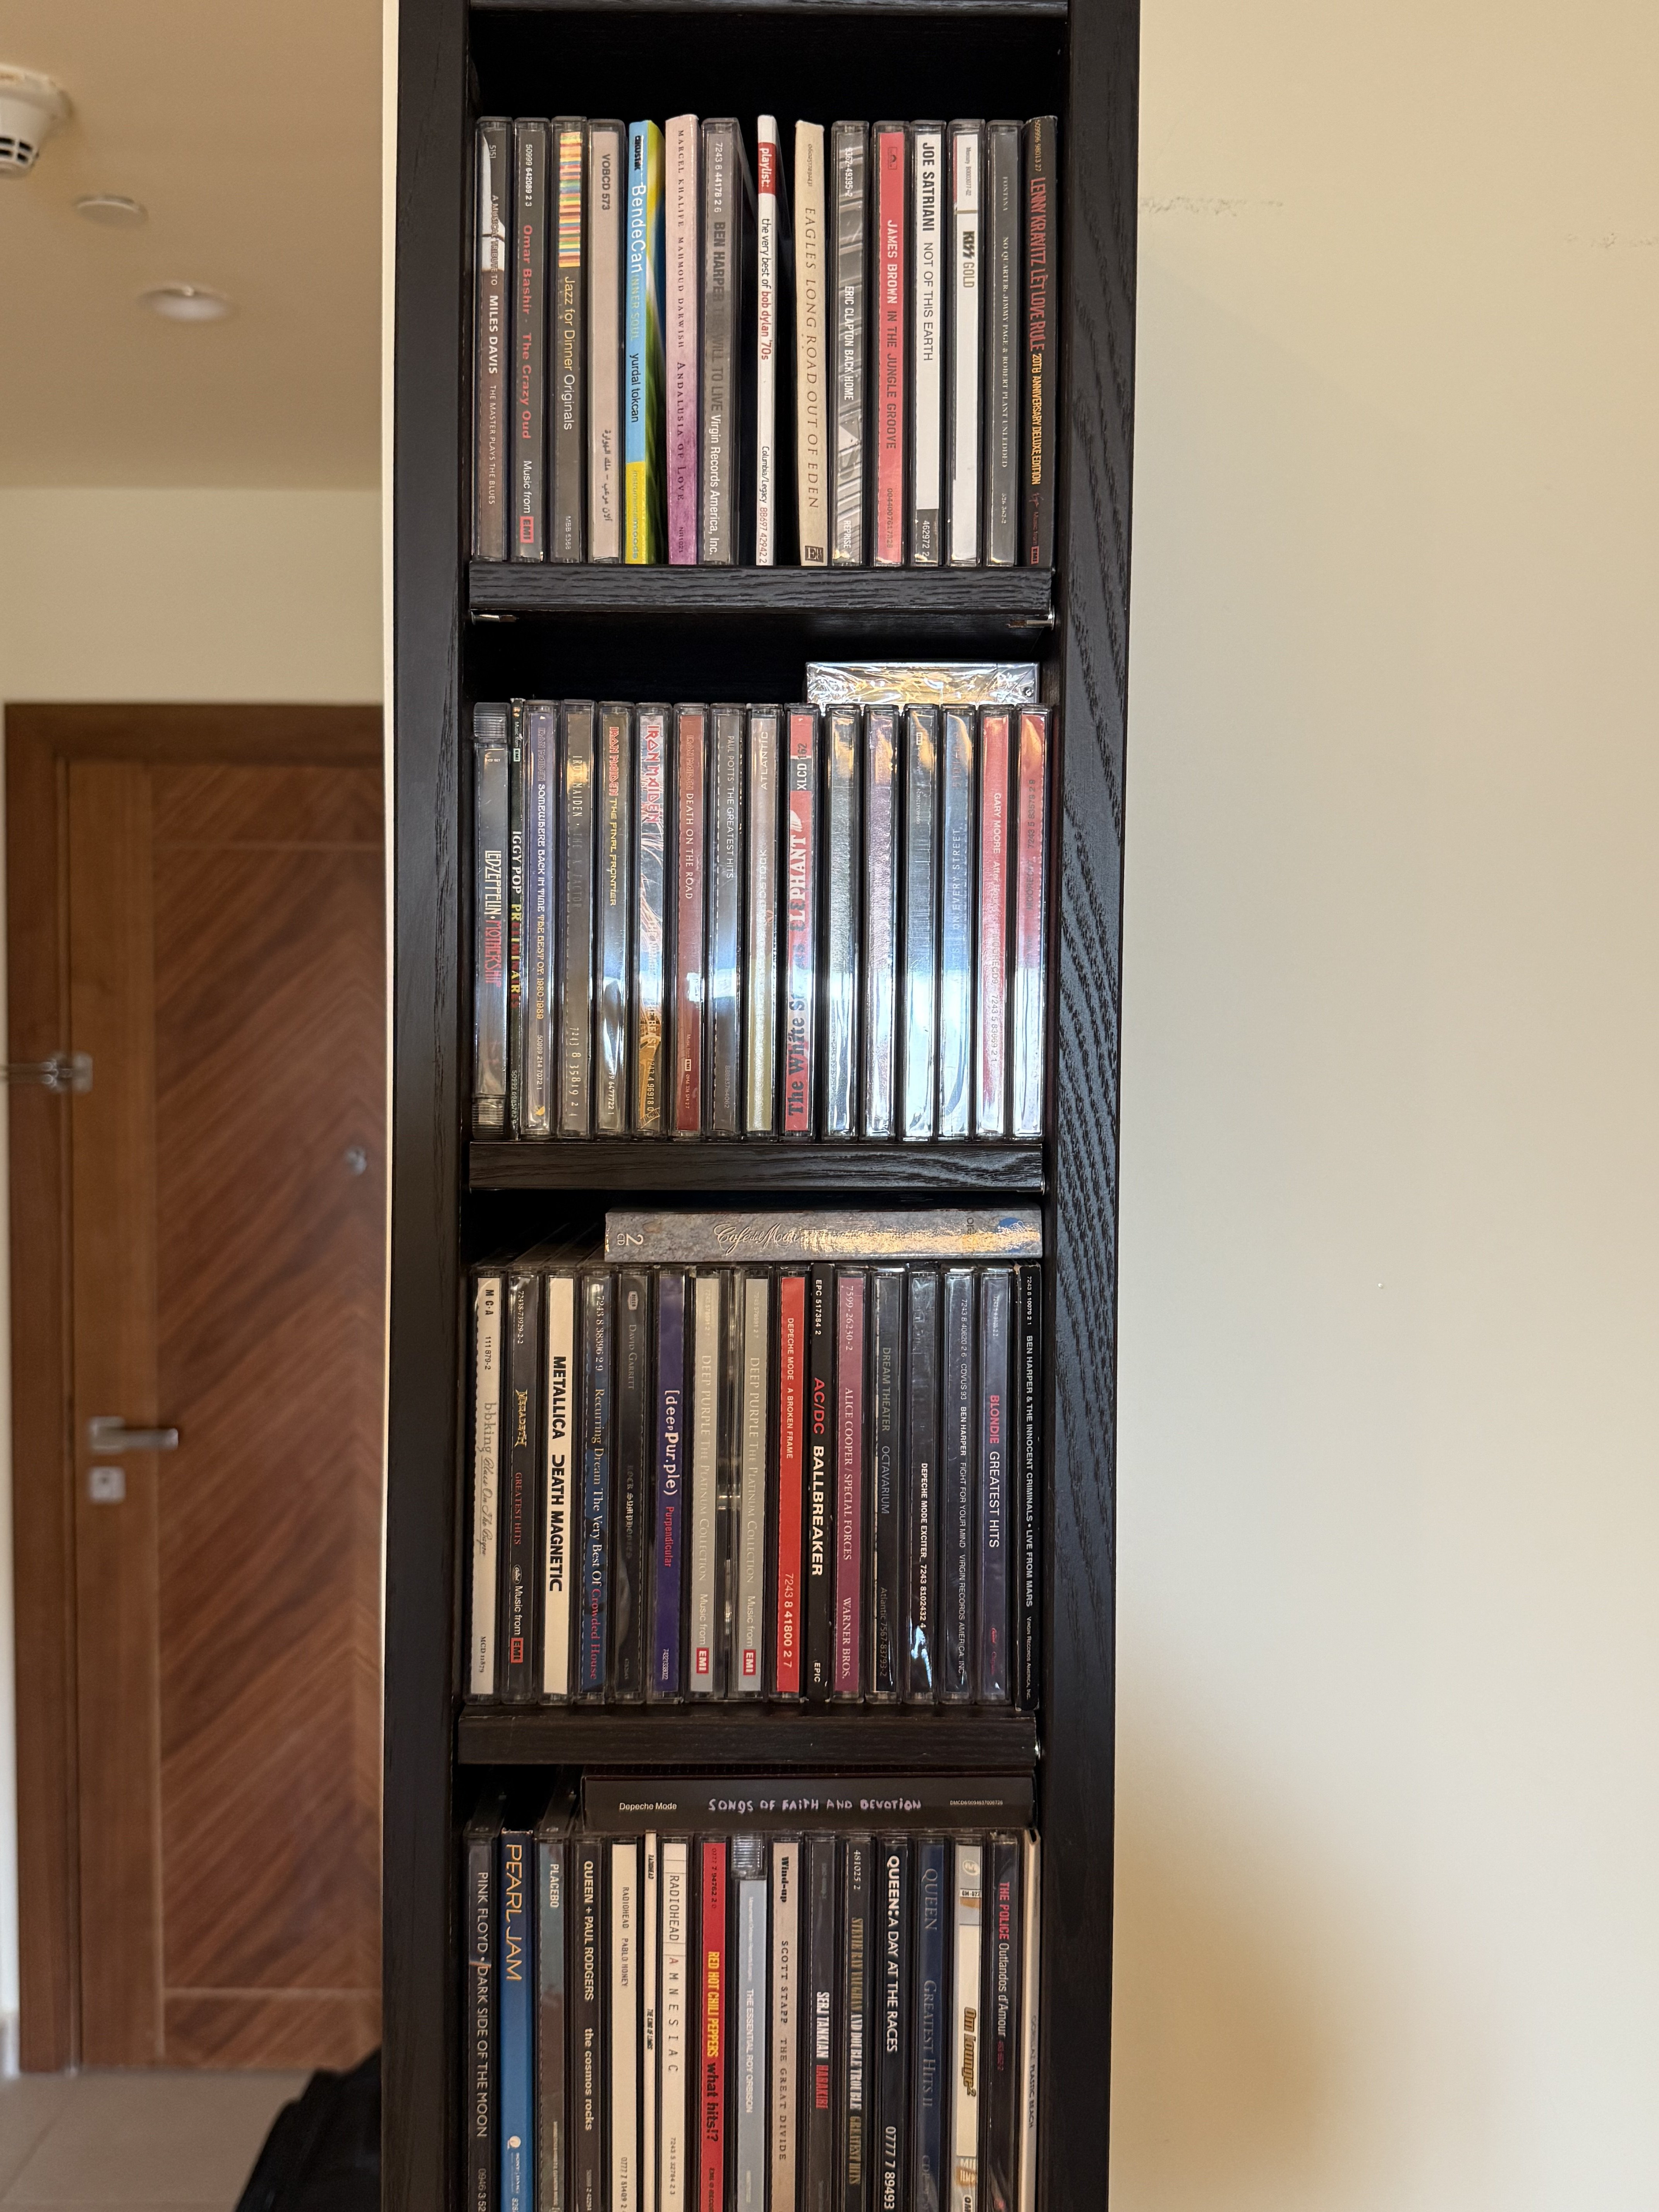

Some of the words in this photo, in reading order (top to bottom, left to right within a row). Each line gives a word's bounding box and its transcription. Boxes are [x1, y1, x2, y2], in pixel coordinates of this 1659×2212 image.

[922, 143, 934, 166] JOE
[922, 172, 935, 231] SATRIANI
[762, 219, 770, 234] the
[805, 208, 816, 270] EAGLES
[887, 220, 897, 258] JAMES
[523, 225, 533, 264] Omar
[759, 236, 769, 256] very
[924, 242, 933, 268] NOT
[762, 258, 771, 277] best
[762, 279, 771, 289] of
[887, 264, 897, 304] BROWN
[924, 271, 933, 287] OF
[523, 268, 533, 314] Bashir
[564, 276, 575, 304] Jazz
[761, 291, 771, 309] bob
[805, 279, 816, 328] LONG
[844, 286, 854, 305] ERIC
[924, 290, 933, 317] THIS
[489, 295, 498, 332] MILES
[565, 309, 575, 326] for
[760, 311, 771, 337] dylan
[844, 308, 854, 346] CLAPTON
[887, 311, 897, 322] IN
[522, 335, 531, 361] The
[563, 330, 575, 371] Dinner
[886, 327, 896, 347] THE
[923, 322, 933, 361] EARTH
[489, 336, 498, 374] DAVIS
[806, 335, 817, 384] ROAD
[844, 350, 854, 373] BACK
[519, 365, 531, 405] Crazy
[844, 376, 854, 400] HOME
[886, 353, 896, 397] JUNGLE
[561, 374, 575, 430] Originals
[807, 391, 817, 428] OUT
[522, 410, 531, 439] Oud
[886, 403, 896, 449] GROOVE
[807, 434, 818, 455] OF
[523, 460, 532, 489] Music
[808, 462, 819, 508] EDEN
[523, 491, 532, 514] from
[523, 519, 531, 541] EMI
[727, 756, 735, 782] POTTS
[760, 732, 768, 790] ATLANTIC
[538, 783, 546, 847] SOMEWHERE
[685, 793, 694, 824] DEATH
[993, 793, 1001, 817] GARY
[511, 831, 521, 861] IGGY
[609, 822, 618, 852] FINAL
[685, 829, 694, 844] ON
[726, 807, 735, 856] GREATEST
[993, 819, 1001, 854] MOORE
[685, 849, 694, 866] THE
[952, 829, 960, 869] STREET
[512, 866, 521, 894] POP
[538, 877, 545, 886] IN
[685, 871, 694, 899] ROAD
[726, 858, 734, 878] HITS
[537, 888, 545, 912] TIME
[952, 877, 960, 910] EVERY
[952, 916, 960, 930] ON
[484, 920, 502, 988] MOTHERSHIP
[788, 1018, 805, 1075] White
[788, 1081, 804, 1116] The
[882, 1347, 891, 1384] DREAM
[552, 1356, 567, 1439] METALLICA
[814, 1377, 825, 1434] AC/DC
[845, 1387, 854, 1418] ALICE
[881, 1387, 891, 1431] THEATER
[591, 1389, 605, 1444] Recurring
[989, 1395, 1000, 1443] BLONDIE
[844, 1421, 854, 1465] COOPER
[593, 1448, 605, 1485] Dream
[881, 1445, 890, 1514] OCTAVARIUM
[989, 1451, 1000, 1516] GREATEST
[593, 1488, 604, 1511] The
[812, 1446, 824, 1575] BALLBREAKER
[843, 1474, 853, 1517] SPECIAL
[590, 1515, 603, 1539] Very
[843, 1520, 852, 1560] FORCES
[989, 1519, 999, 1547] HITS
[549, 1510, 564, 1592] MAGNETIC
[592, 1544, 603, 1567] Best
[592, 1570, 603, 1587] Of
[591, 1588, 602, 1639] Crowded
[842, 1597, 852, 1645] WARNER
[590, 1644, 601, 1679] House
[842, 1648, 851, 1679] BROS.
[620, 1802, 653, 1811] Depeche
[477, 1872, 488, 1904] PINK
[506, 1844, 522, 1922] PEARL
[549, 1864, 559, 1908] PLACEBO
[584, 1860, 593, 1903] QUEEN
[477, 1908, 488, 1953] FLOYD
[584, 1916, 593, 1944] PAUL
[506, 1926, 522, 1980] JAM
[708, 1951, 720, 1968] RED
[477, 1965, 488, 2003] DARK
[584, 1947, 594, 2001] RODGERS
[708, 1971, 720, 1989] HOT
[708, 1992, 720, 2015] CHILI
[780, 1986, 788, 2024] STAPP
[816, 1992, 830, 2014] SERJ
[477, 2007, 488, 2036] SIDE
[584, 2028, 594, 2047] the
[708, 2018, 720, 2057] PEPPERS
[816, 2016, 829, 2058] TANKIAN
[477, 2040, 488, 2058] OF
[477, 2062, 488, 2089] THE
[584, 2051, 592, 2095] cosmos
[707, 2063, 718, 2097] what
[476, 2092, 487, 2138] MOON
[584, 2099, 594, 2131] rocks
[707, 2103, 718, 2142] hits!?
